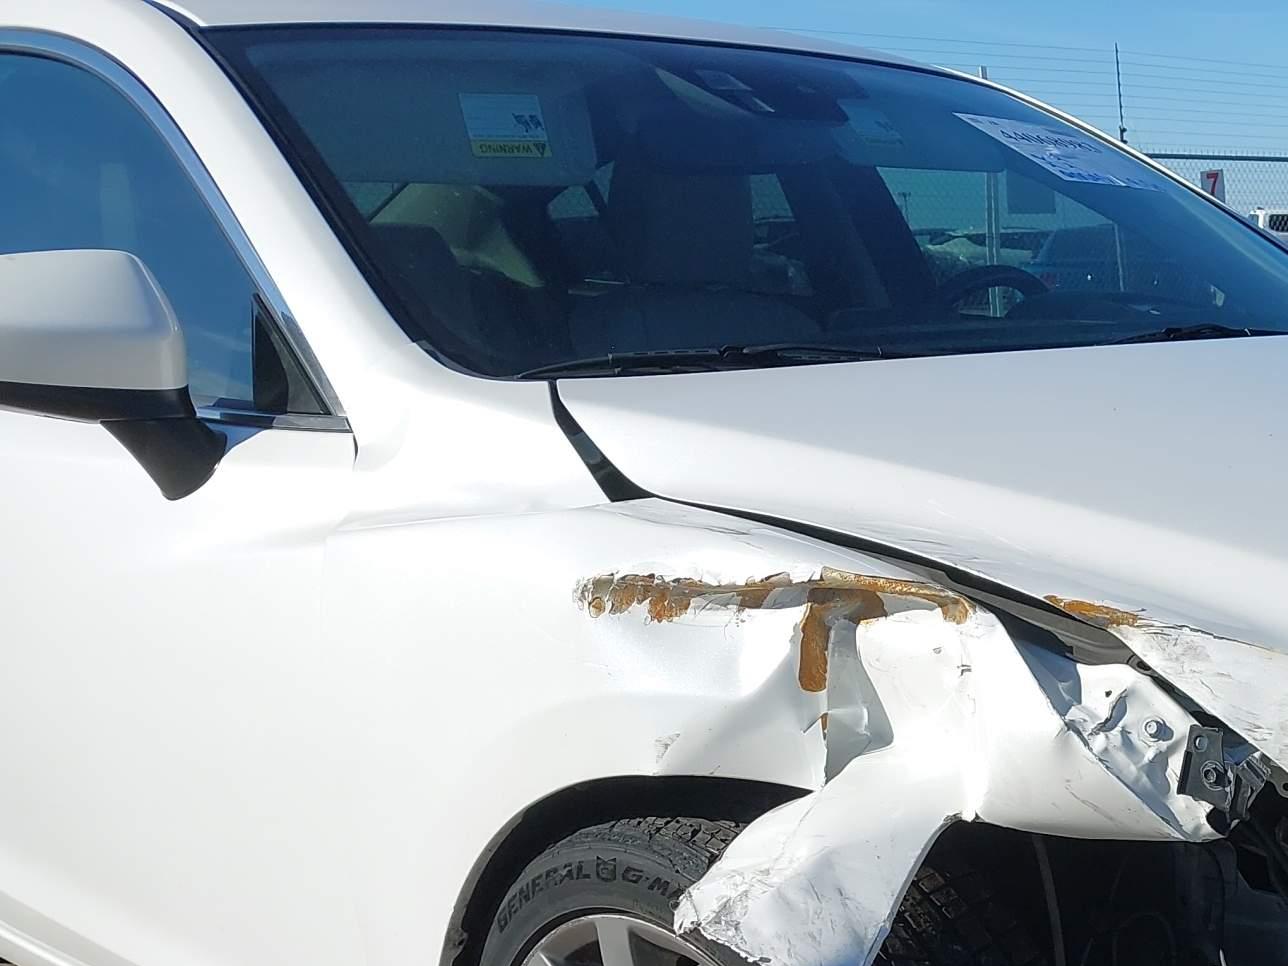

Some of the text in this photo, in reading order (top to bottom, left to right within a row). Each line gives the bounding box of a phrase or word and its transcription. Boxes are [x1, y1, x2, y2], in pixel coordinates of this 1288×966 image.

[479, 143, 533, 154] WARNING
[1206, 173, 1219, 195] 7
[496, 860, 591, 933] GENERAL
